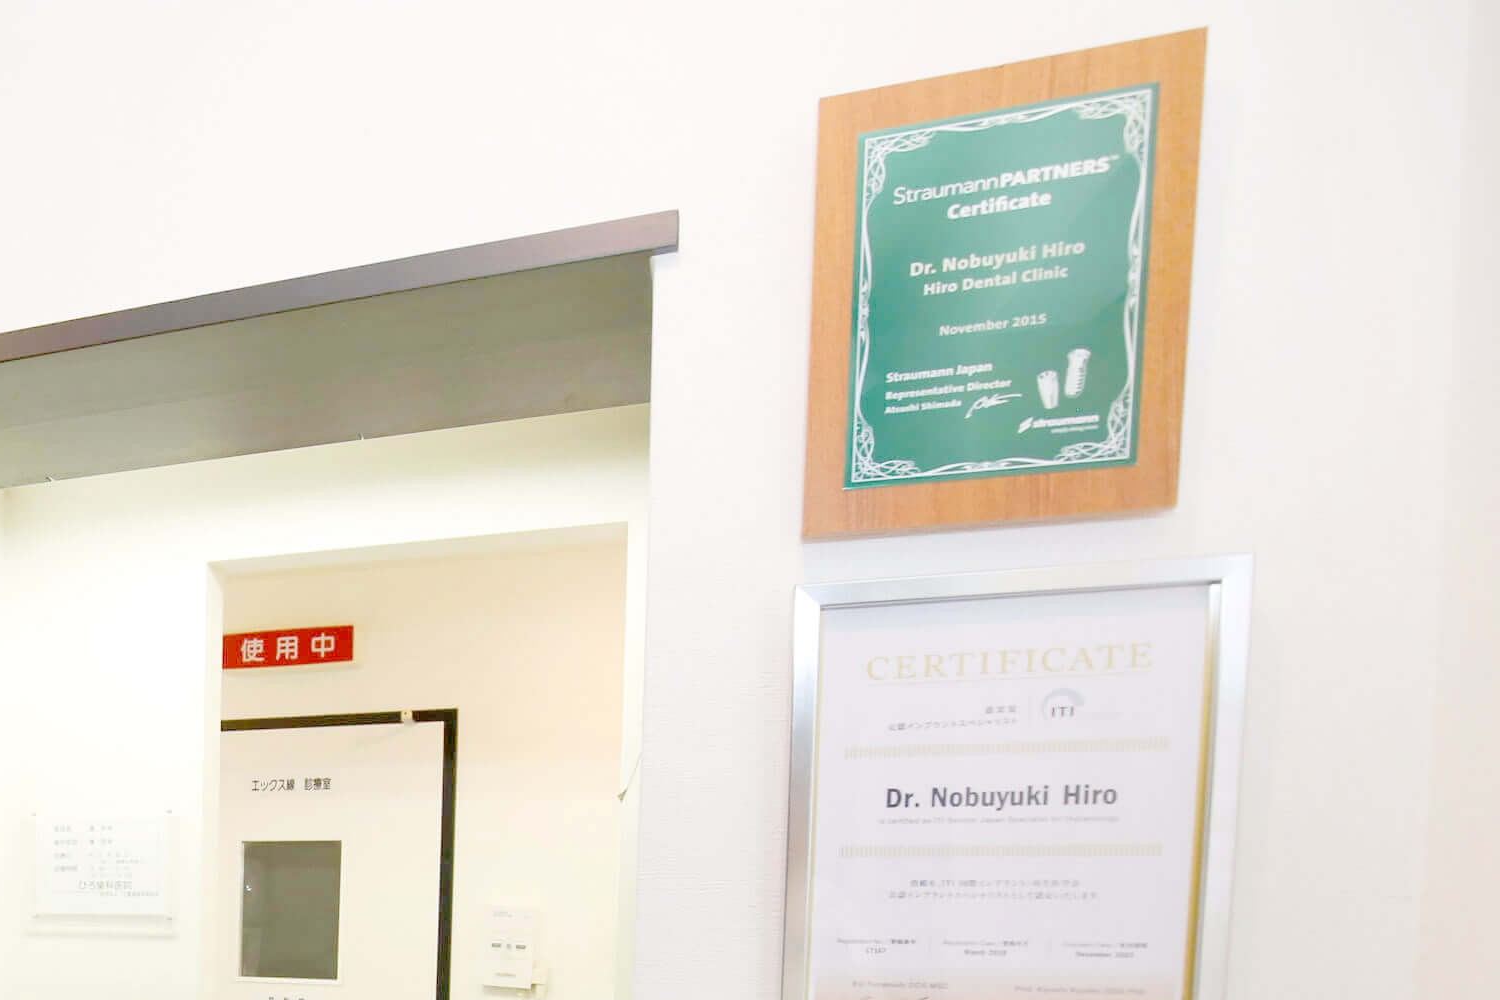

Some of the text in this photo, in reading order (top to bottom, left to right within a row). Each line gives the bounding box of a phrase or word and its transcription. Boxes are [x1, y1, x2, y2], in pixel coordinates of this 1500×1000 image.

[947, 192, 1052, 220] Certificate
[910, 241, 1086, 277] Dr. Nobuyuki Hiro
[923, 266, 1069, 296] Hiro Dental Clinic
[939, 313, 1047, 336] November 2015
[885, 363, 993, 384] Straumann Japan
[885, 379, 1012, 402] Representative Director
[240, 632, 336, 662] 使用中
[866, 640, 1156, 681] CERTIFICATE
[1050, 704, 1076, 718] ITI
[252, 778, 296, 792] エックス線
[886, 784, 1118, 811] Dr. Nobuyuki Hiro
